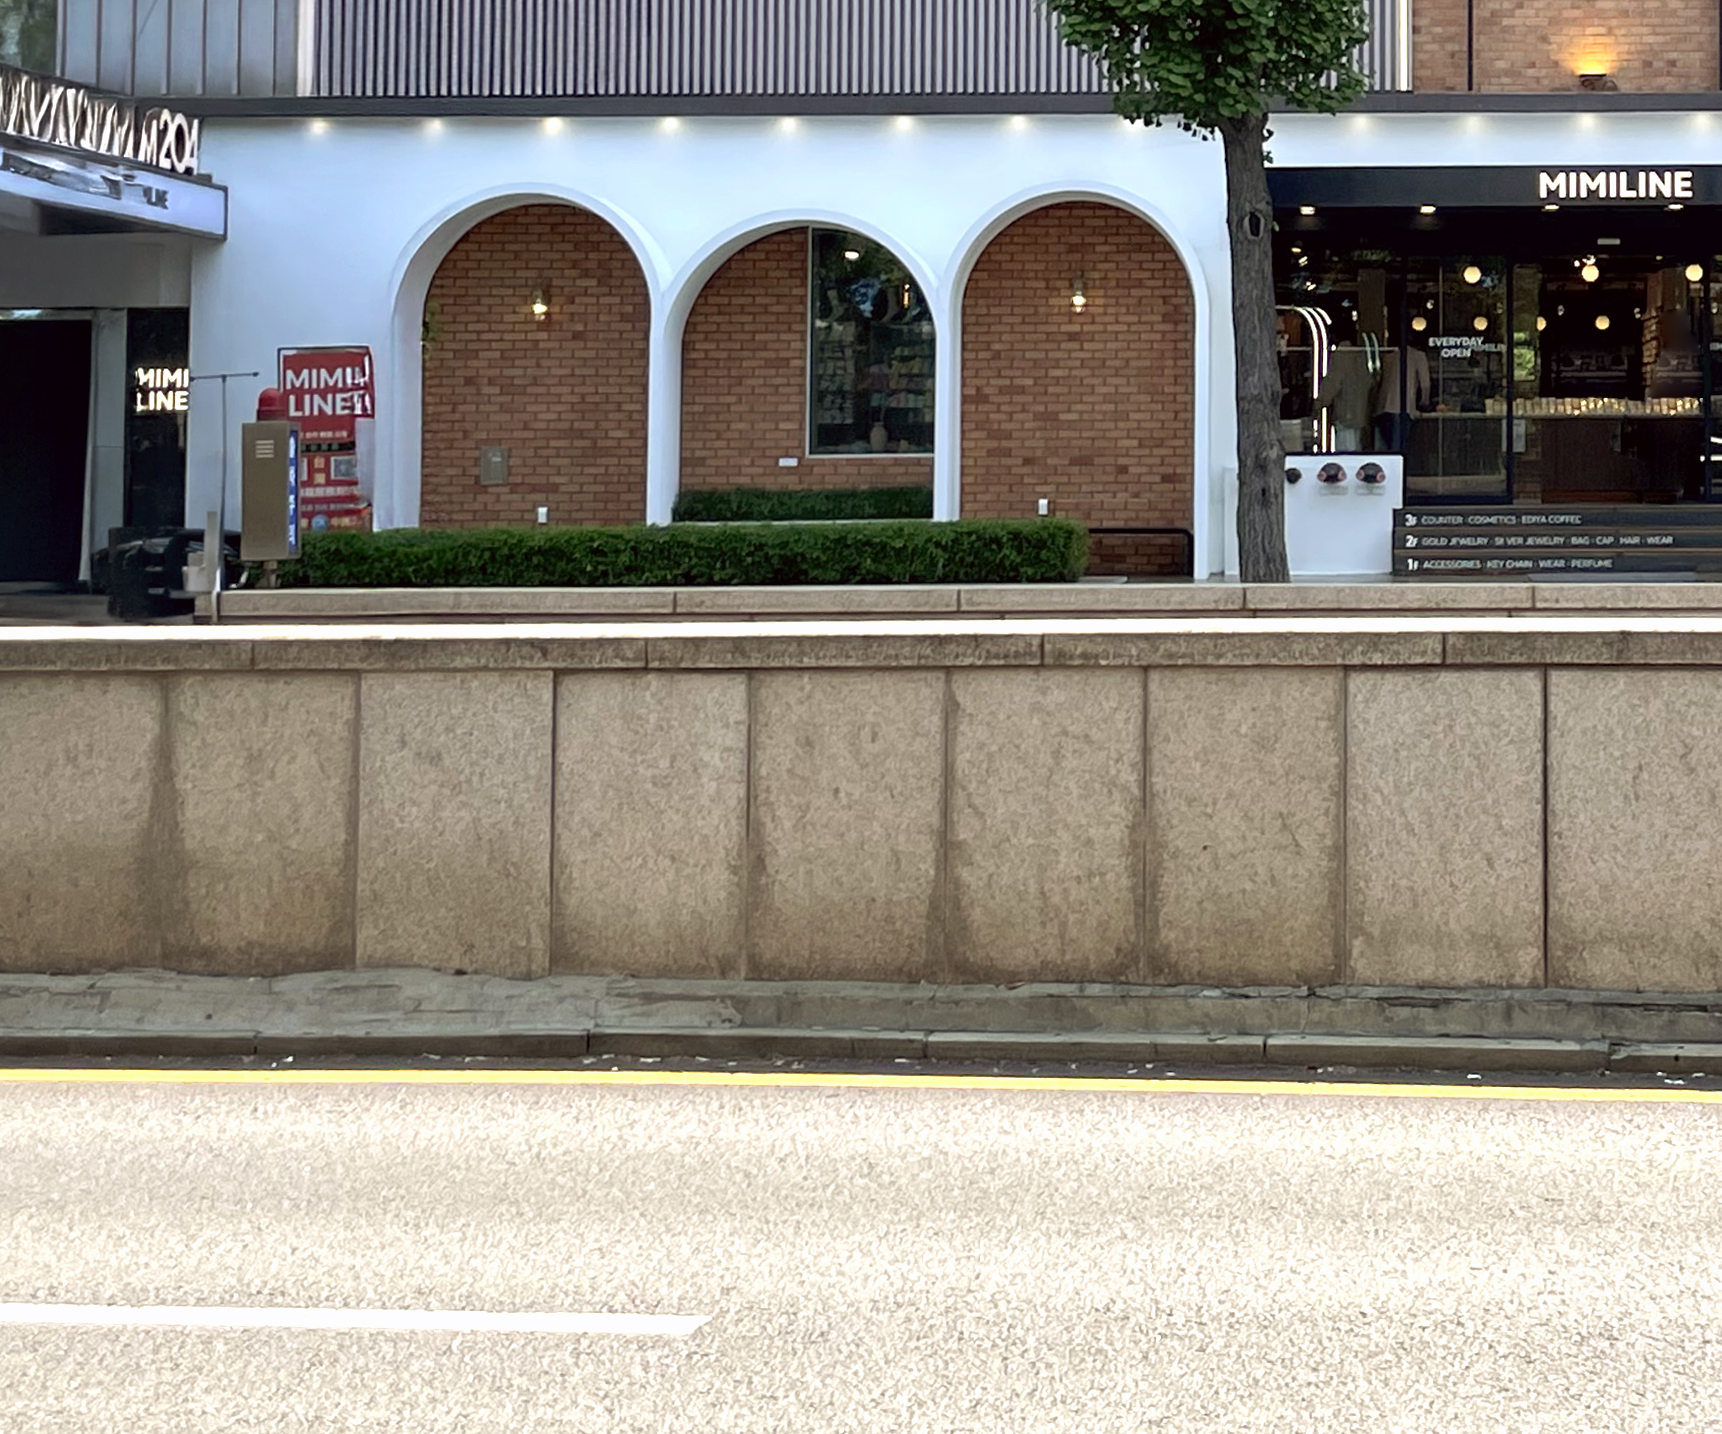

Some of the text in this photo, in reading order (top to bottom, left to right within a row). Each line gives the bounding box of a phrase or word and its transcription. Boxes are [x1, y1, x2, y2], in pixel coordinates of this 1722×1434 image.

[1539, 170, 1694, 199] MIMILINE
[1428, 337, 1485, 347] EVERYDAY
[1441, 348, 1472, 358] OPEN
[135, 367, 189, 388] MIMI
[136, 390, 190, 412] LINE
[1421, 515, 1463, 525] COUNTER
[1467, 515, 1517, 525] COSMETICS
[1421, 536, 1448, 546] GOLD
[1596, 536, 1615, 545] CAP
